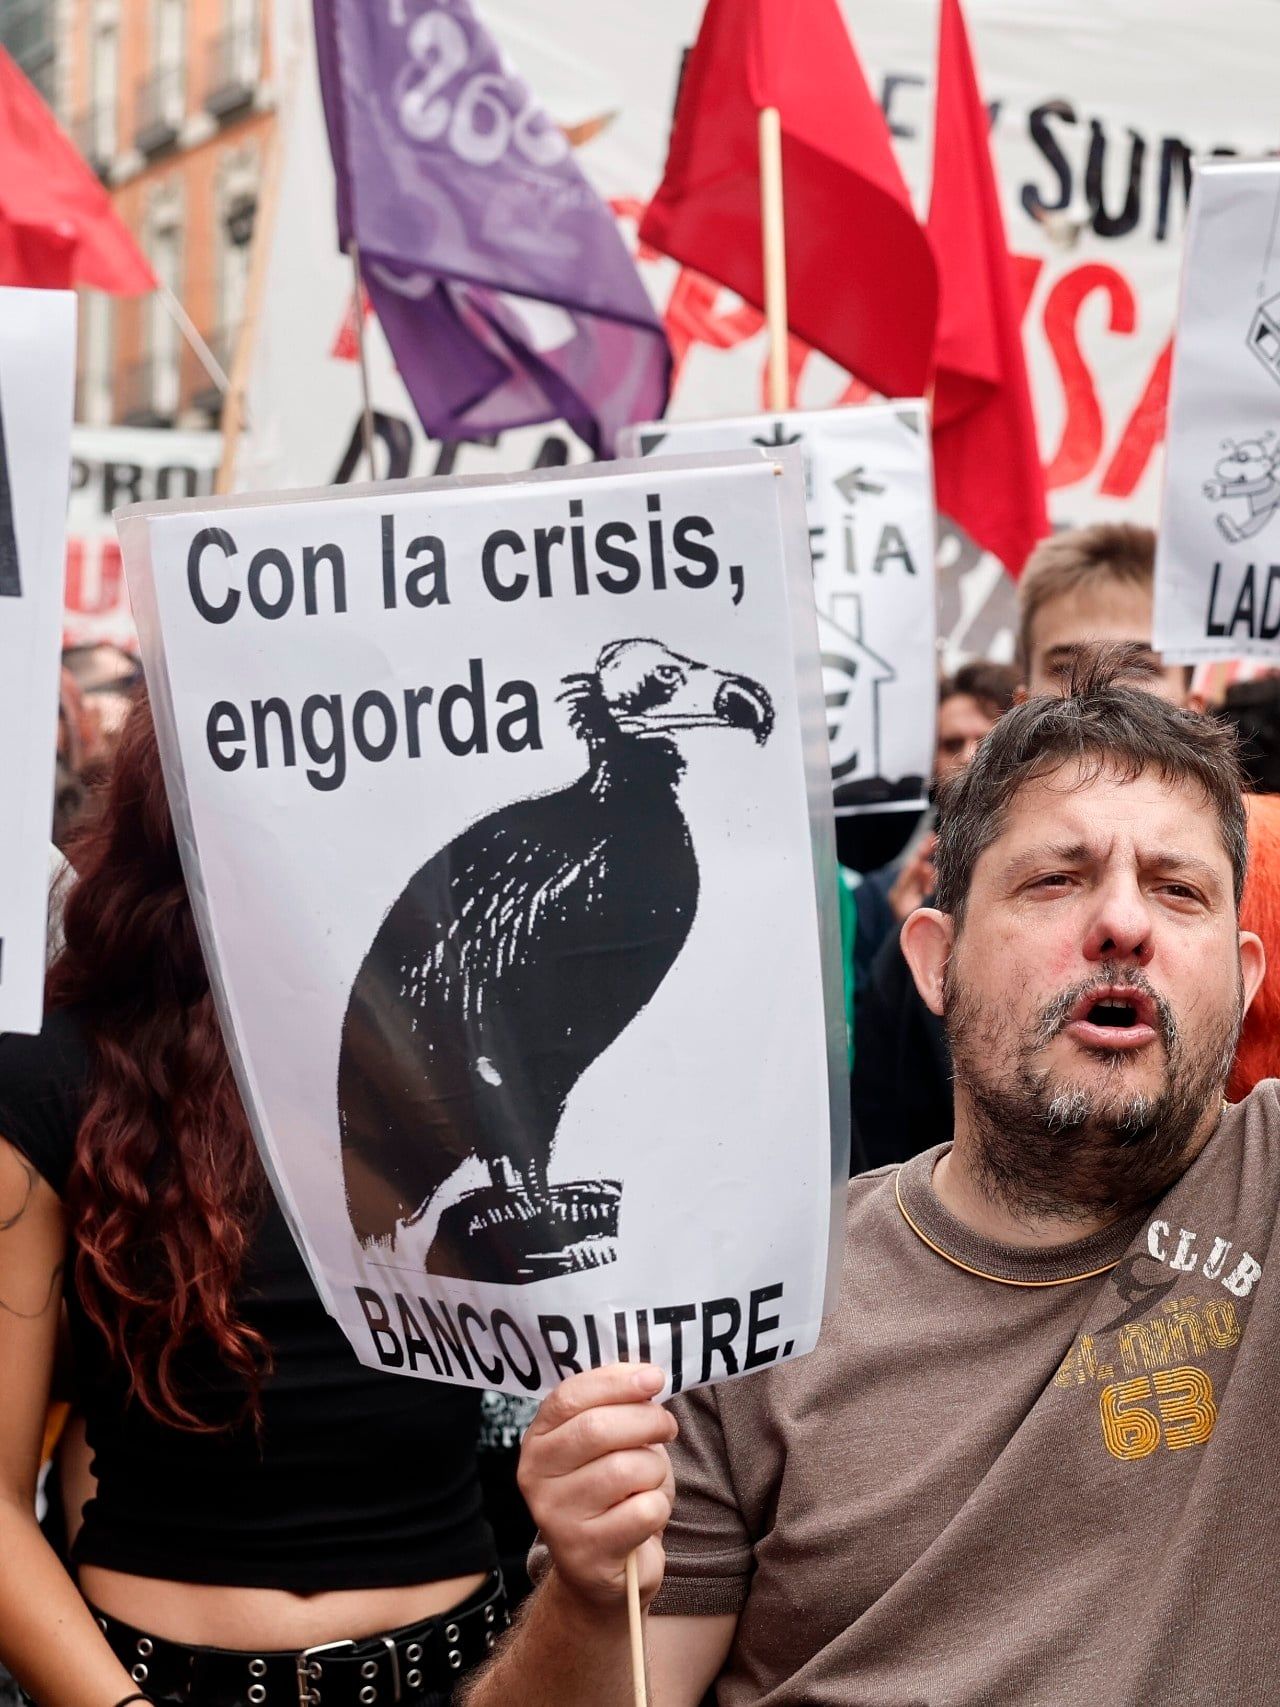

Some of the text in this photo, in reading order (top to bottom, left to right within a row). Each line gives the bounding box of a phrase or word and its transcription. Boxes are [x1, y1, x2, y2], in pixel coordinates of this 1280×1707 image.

[187, 493, 745, 624] Con la crisis,
[206, 657, 544, 792] engorda
[1147, 1219, 1263, 1298] CLUB
[354, 1286, 542, 1391] BANCO
[1100, 1365, 1219, 1462] 63
